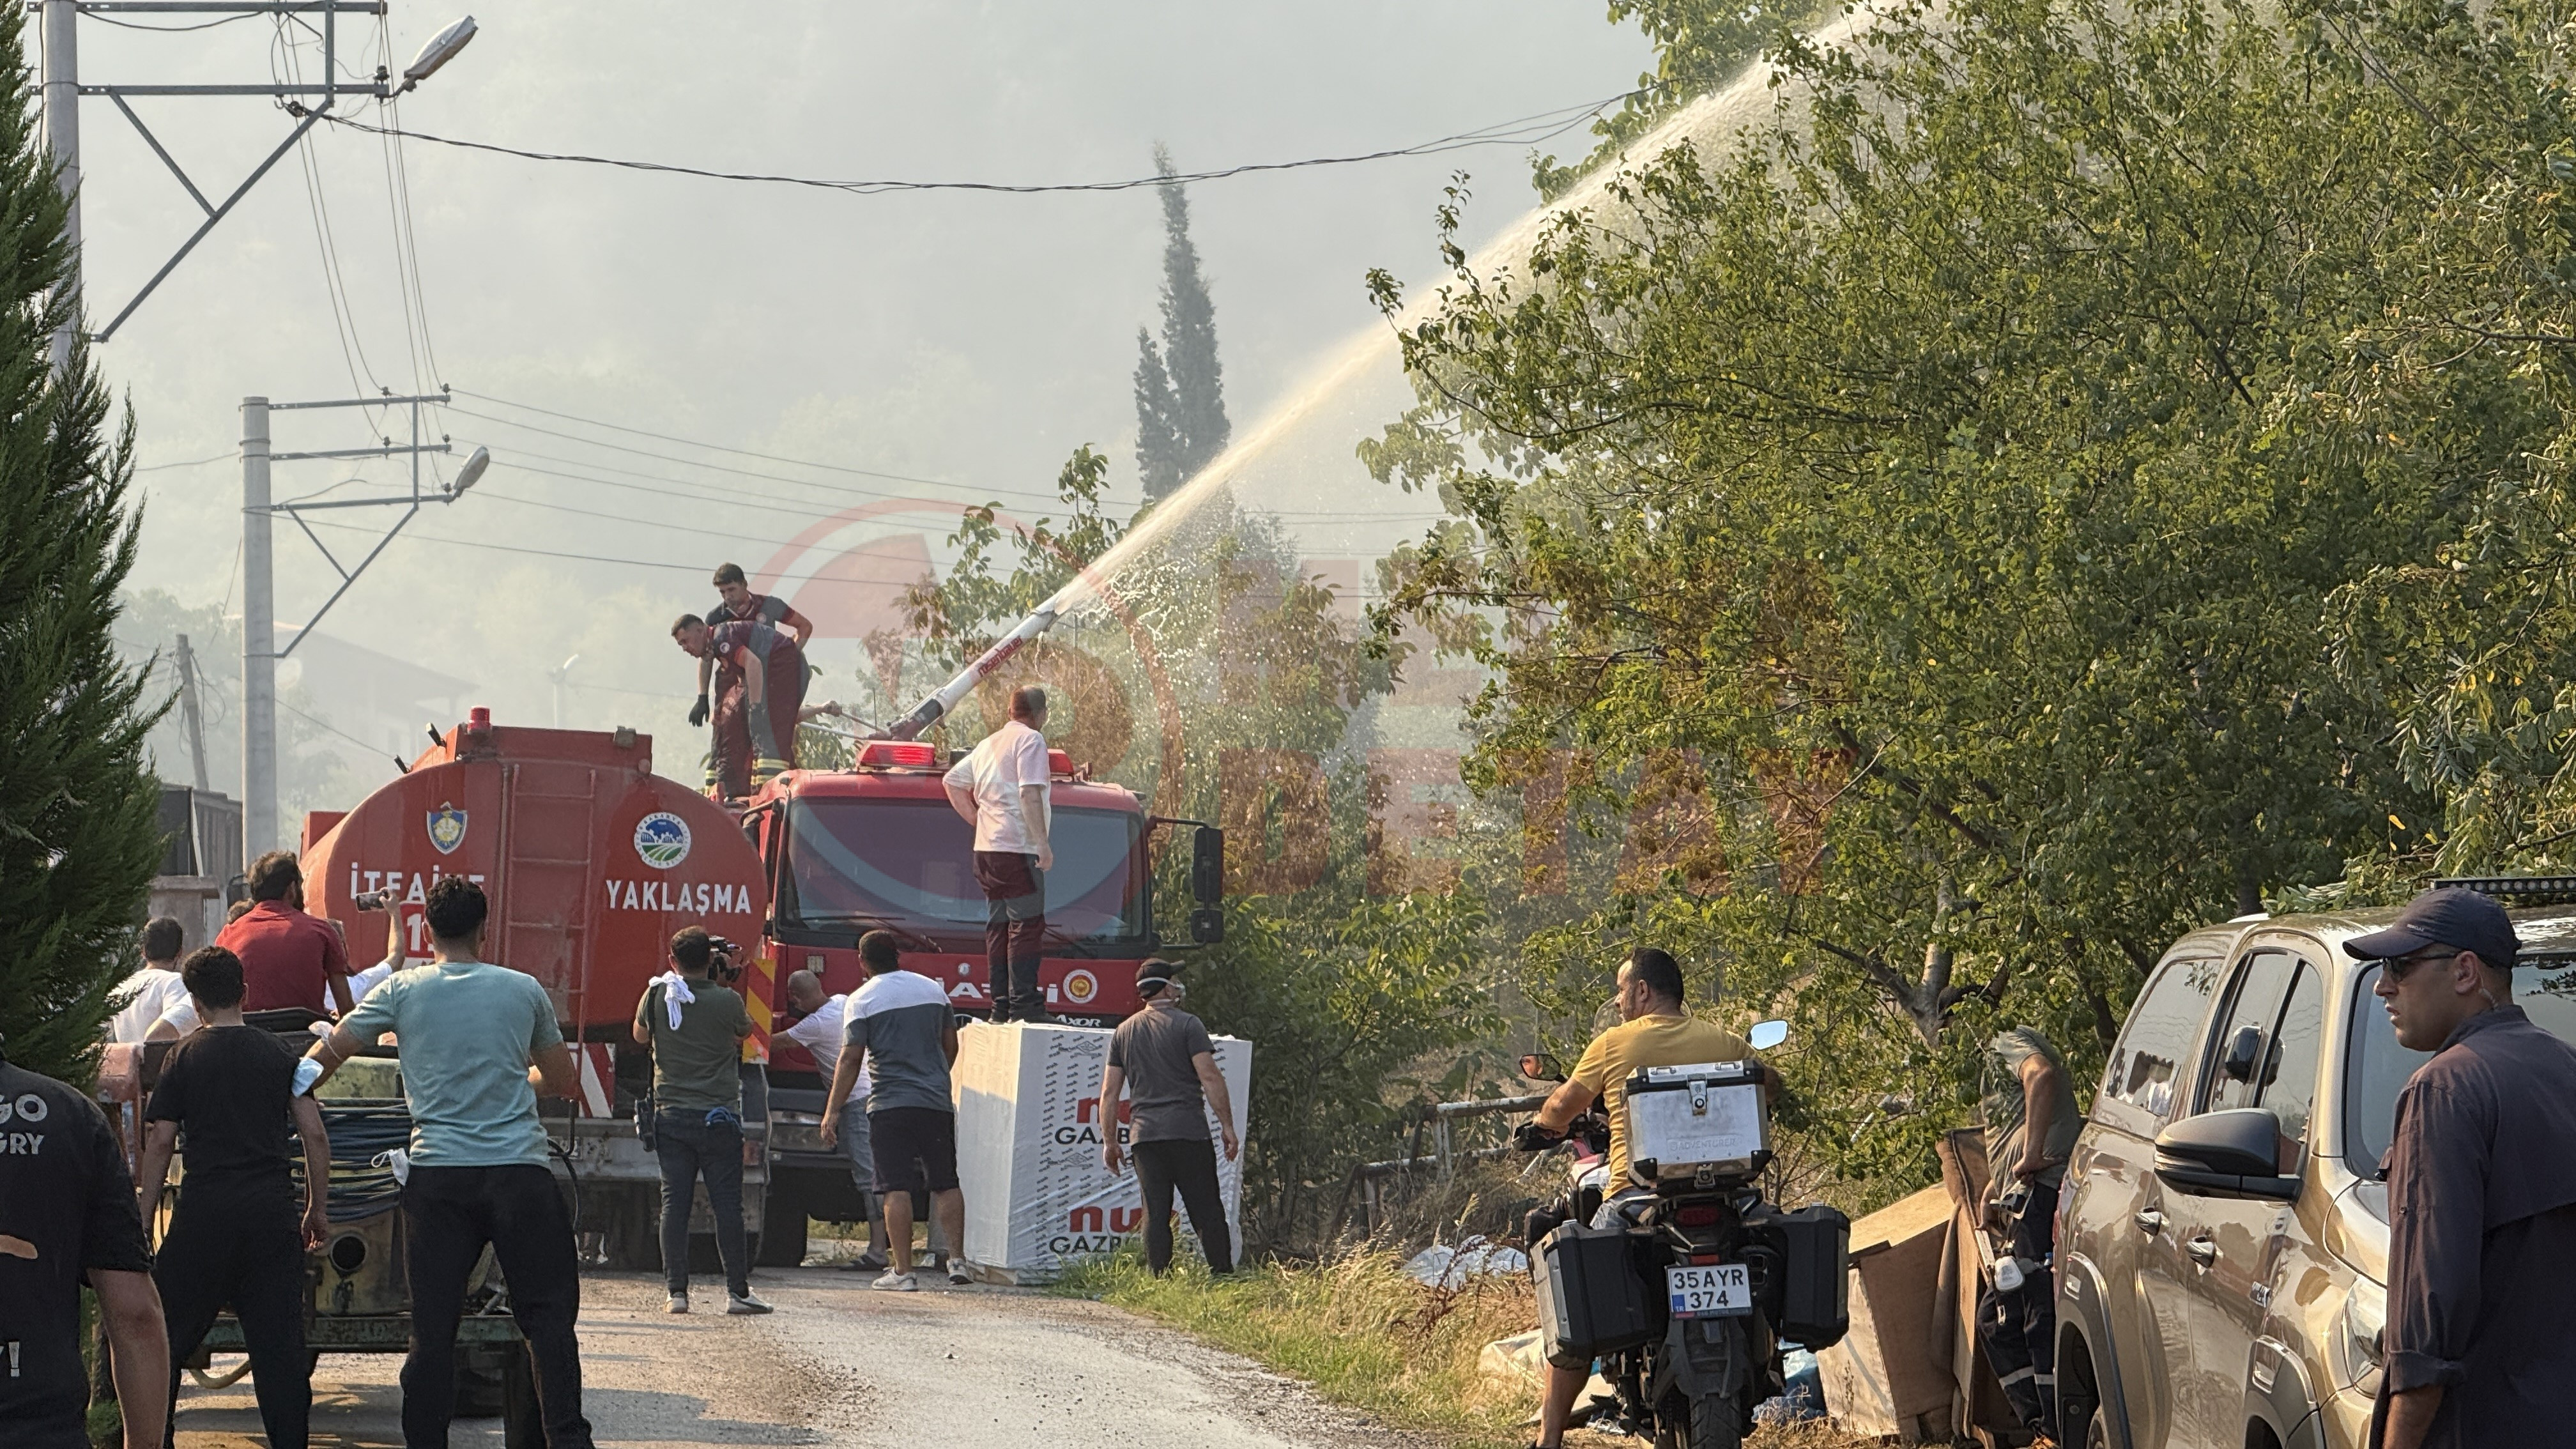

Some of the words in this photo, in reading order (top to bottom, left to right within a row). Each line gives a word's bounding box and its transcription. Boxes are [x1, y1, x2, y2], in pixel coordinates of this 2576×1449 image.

[606, 880, 751, 916] YAKLAŞMA
[1674, 1271, 1699, 1289] 35
[1703, 1269, 1744, 1287] AYR
[1690, 1290, 1729, 1309] 374
